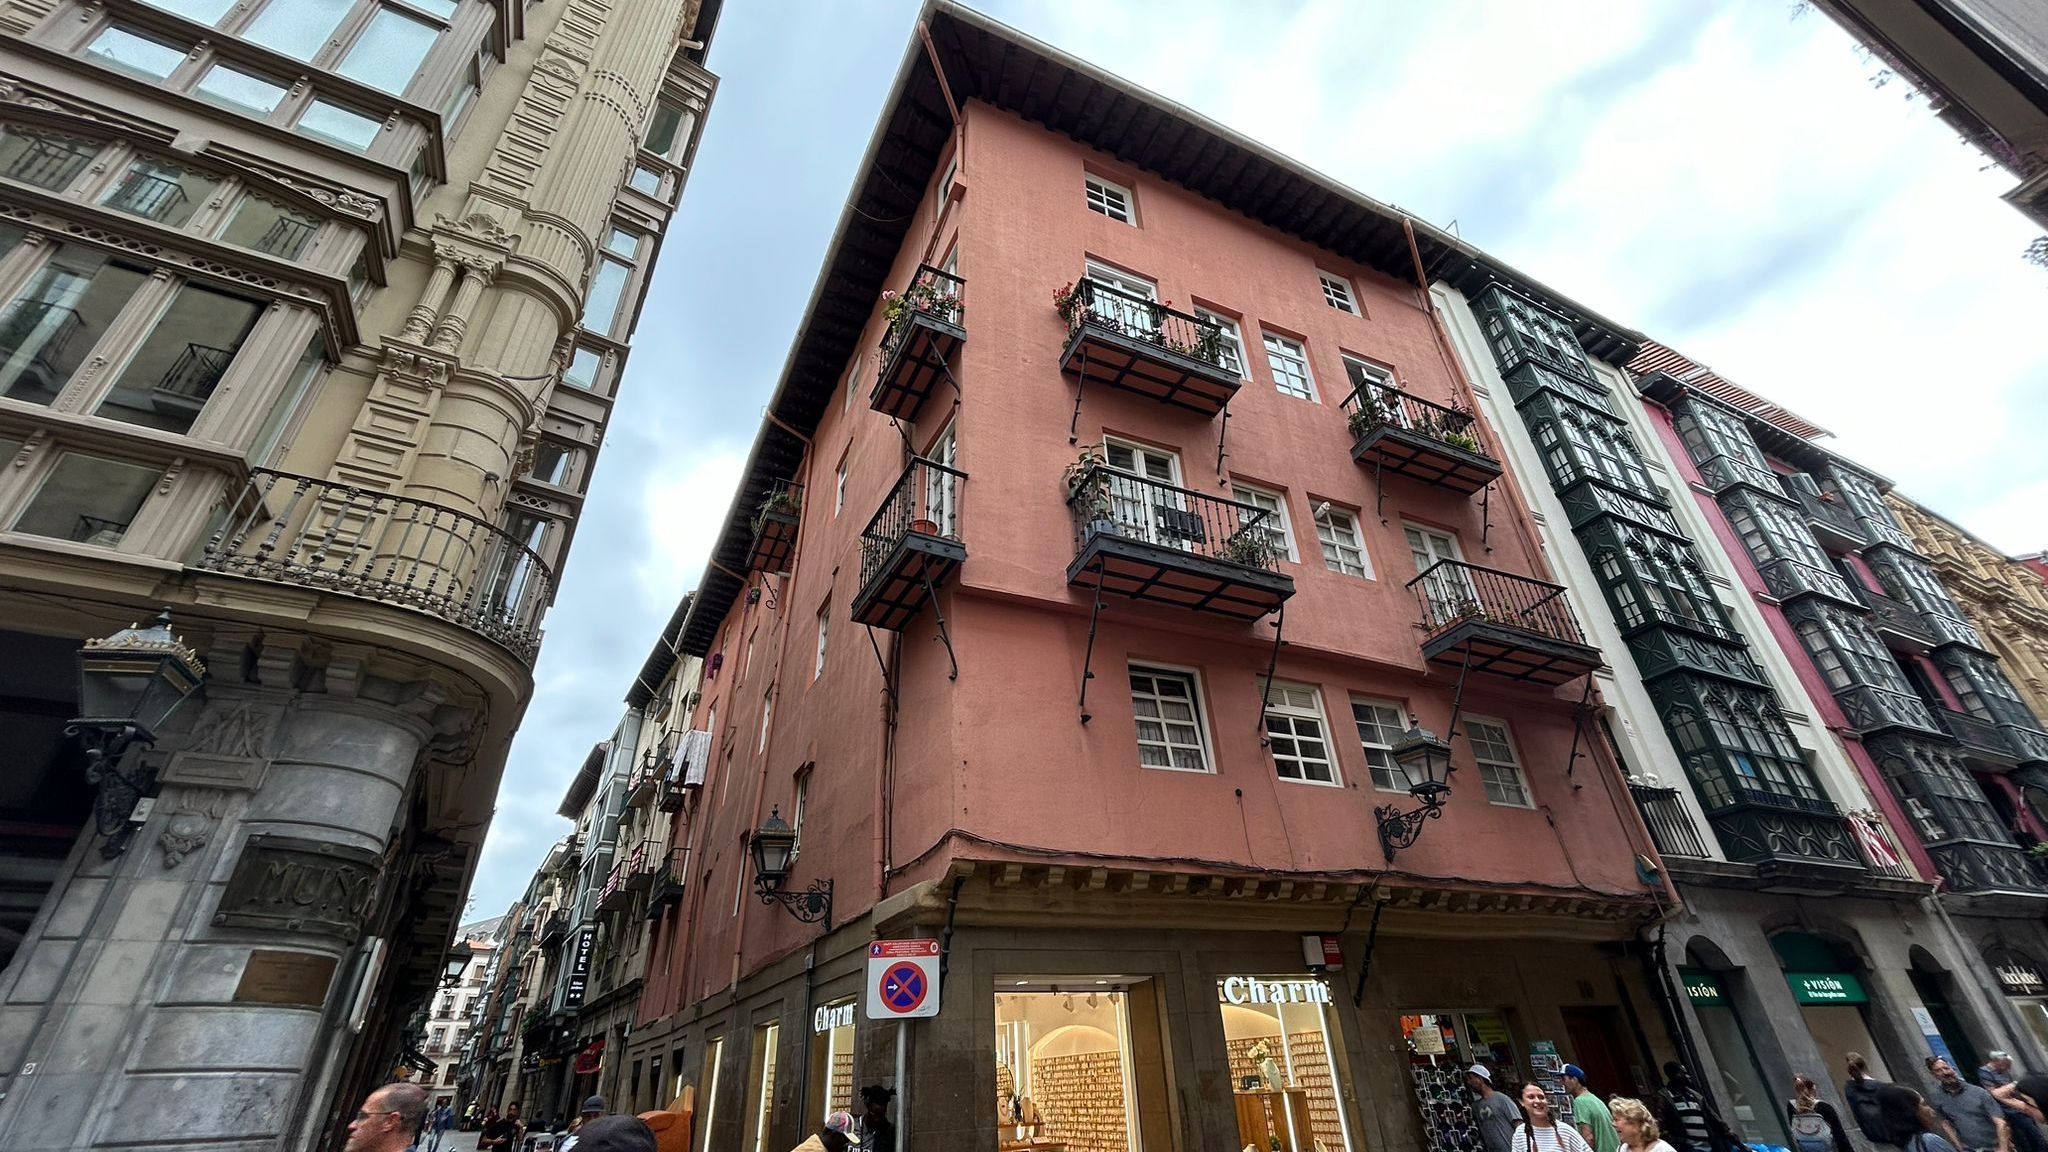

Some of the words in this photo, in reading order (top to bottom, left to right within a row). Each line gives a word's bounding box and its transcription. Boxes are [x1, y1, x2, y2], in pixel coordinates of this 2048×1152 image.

[577, 933, 592, 971] HOTEL
[1224, 976, 1329, 1005] Charm
[1685, 983, 1719, 998] ISIÓN
[814, 1003, 855, 1033] Charm
